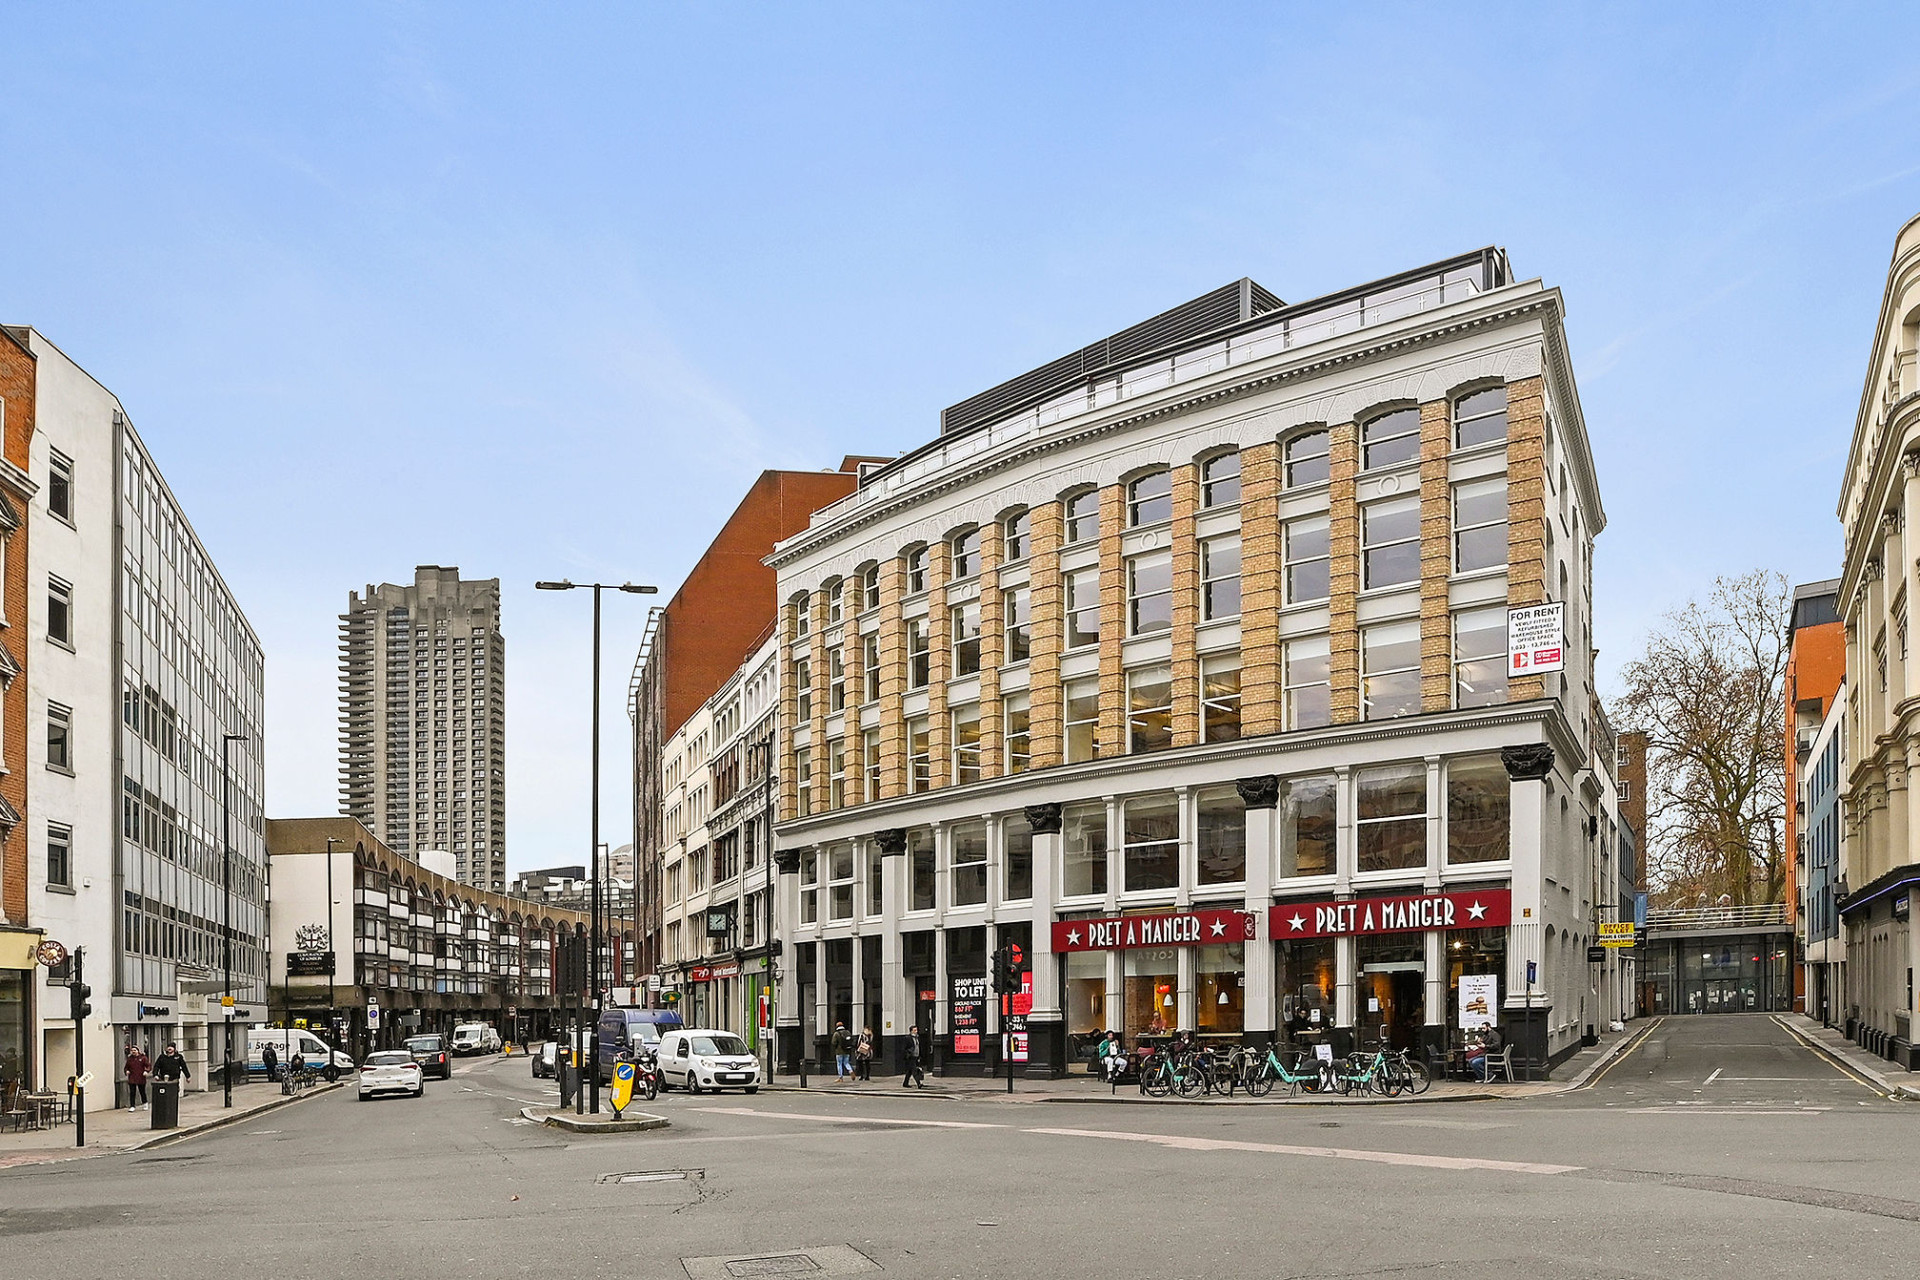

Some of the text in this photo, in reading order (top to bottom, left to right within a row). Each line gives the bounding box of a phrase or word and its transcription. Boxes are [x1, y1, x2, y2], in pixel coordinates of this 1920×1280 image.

[1510, 606, 1560, 621] FOR RENT
[1518, 623, 1554, 631] REFURBISHED
[1511, 630, 1543, 638] WAREHOUSE
[1314, 897, 1455, 934] PRET A MANGER
[1088, 916, 1201, 947] PRET A MANGER
[41, 942, 60, 950] COSTA
[954, 987, 968, 998] TO
[255, 1042, 291, 1051] Stag
